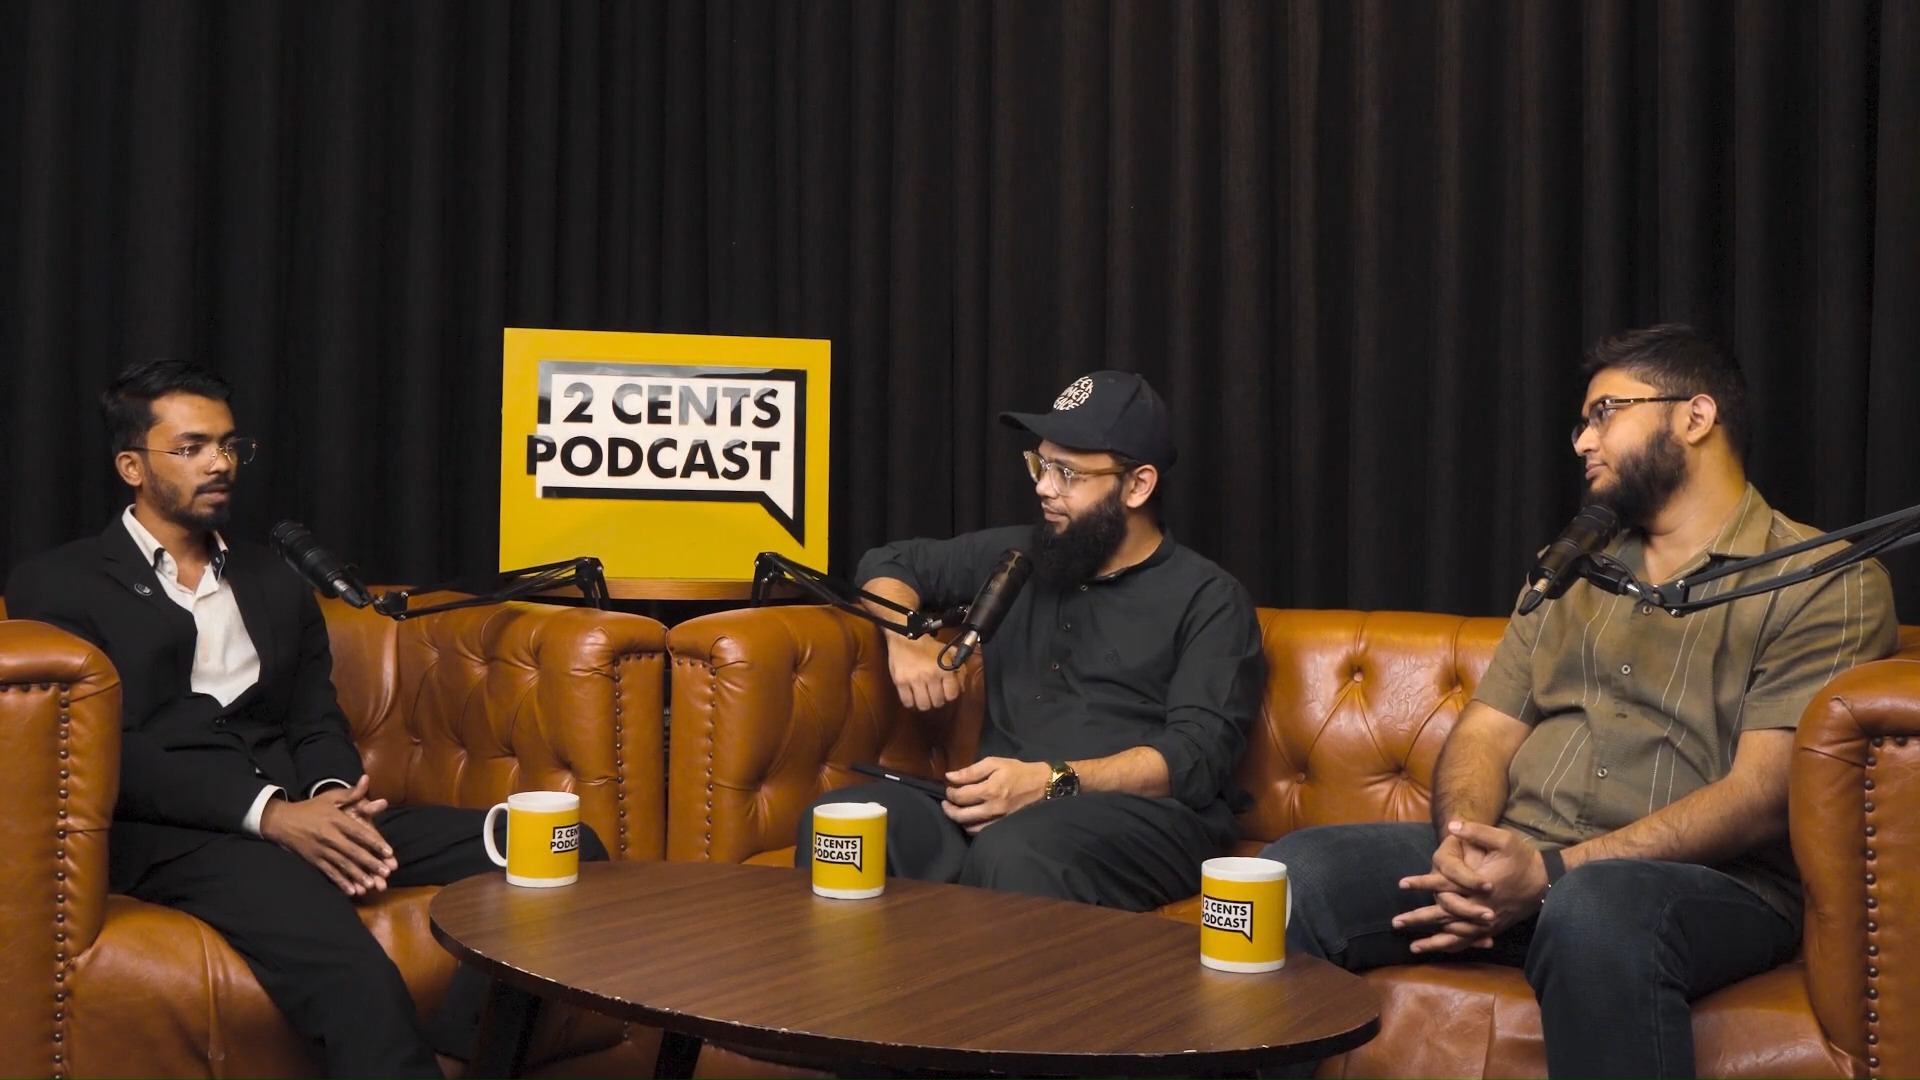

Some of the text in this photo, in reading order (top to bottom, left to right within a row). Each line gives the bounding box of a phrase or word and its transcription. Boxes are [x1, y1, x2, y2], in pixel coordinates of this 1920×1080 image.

[563, 382, 781, 428] 2 CENTS
[526, 435, 780, 480] PODCAST
[557, 828, 579, 839] 2 CEN
[550, 838, 578, 849] PODCA
[817, 837, 857, 849] 2 CENTS
[814, 847, 857, 861] PODCAST
[1204, 900, 1247, 916] 2 CENTS
